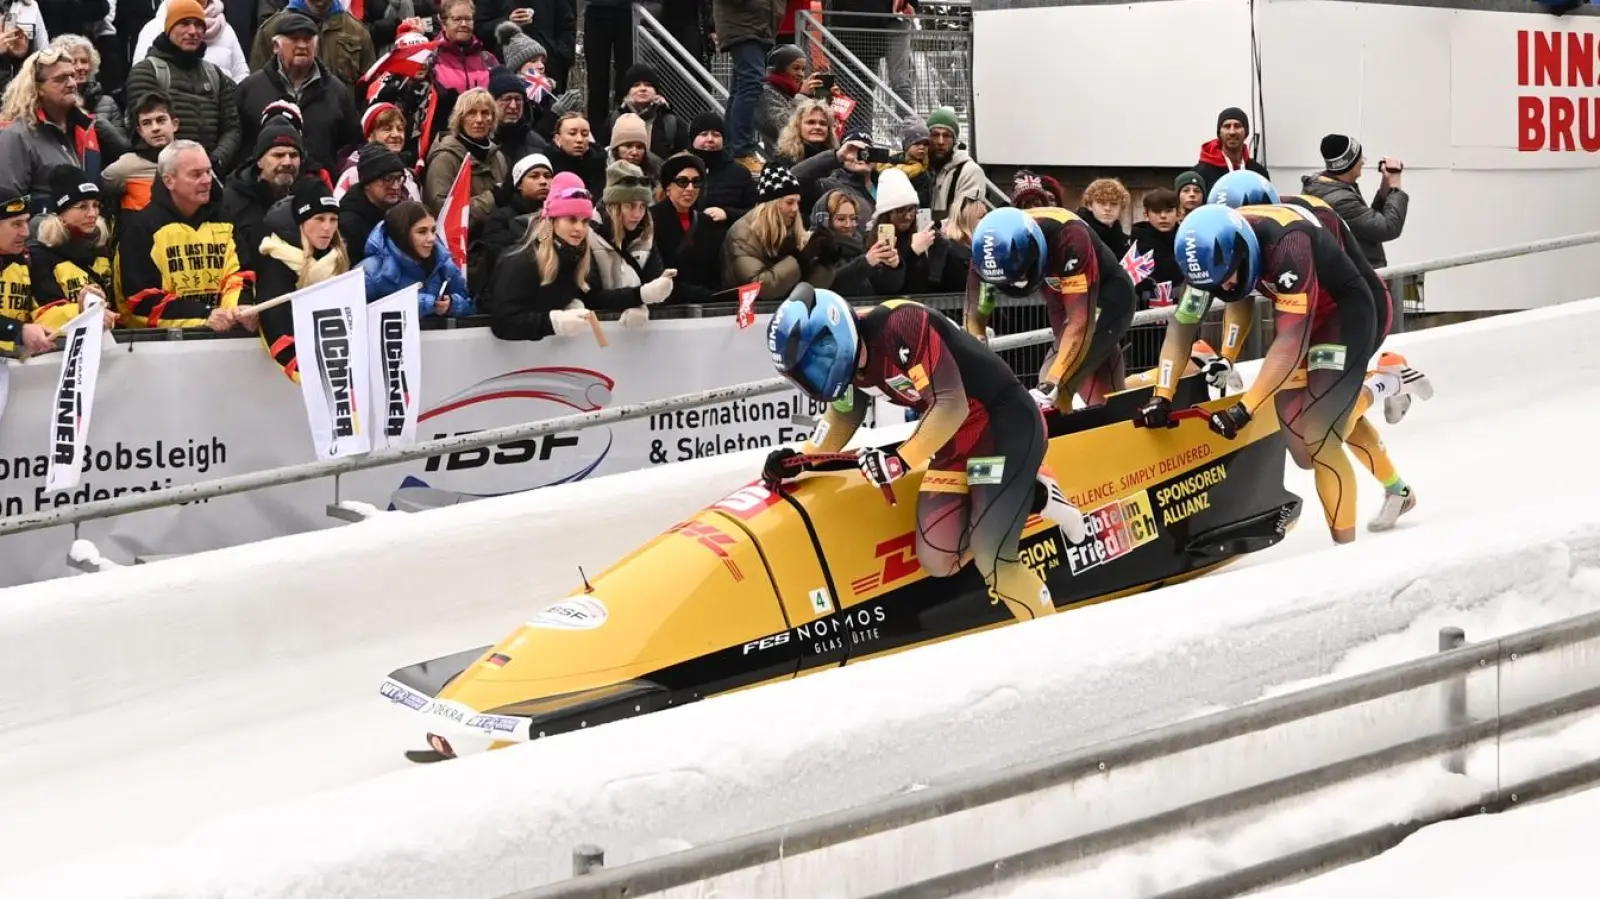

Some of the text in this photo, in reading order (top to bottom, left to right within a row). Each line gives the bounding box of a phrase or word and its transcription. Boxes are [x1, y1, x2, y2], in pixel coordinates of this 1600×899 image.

[1517, 30, 1600, 87] INN
[1517, 96, 1600, 152] BRU
[313, 308, 353, 438] LOCHNER
[381, 311, 405, 437] LOCHNER
[650, 395, 797, 430] International
[649, 438, 668, 464] &
[677, 433, 771, 462] Skeleton
[1120, 464, 1156, 491] SIMPLY
[1159, 443, 1213, 473] DELIVERED.
[1156, 464, 1227, 508] SPONSOREN
[1163, 492, 1211, 527] ALLIANZ
[1068, 514, 1157, 573] Friedrich
[815, 592, 826, 608] 4
[743, 605, 886, 655] FES NOMOS
[815, 628, 880, 654] GLASÜTTE
